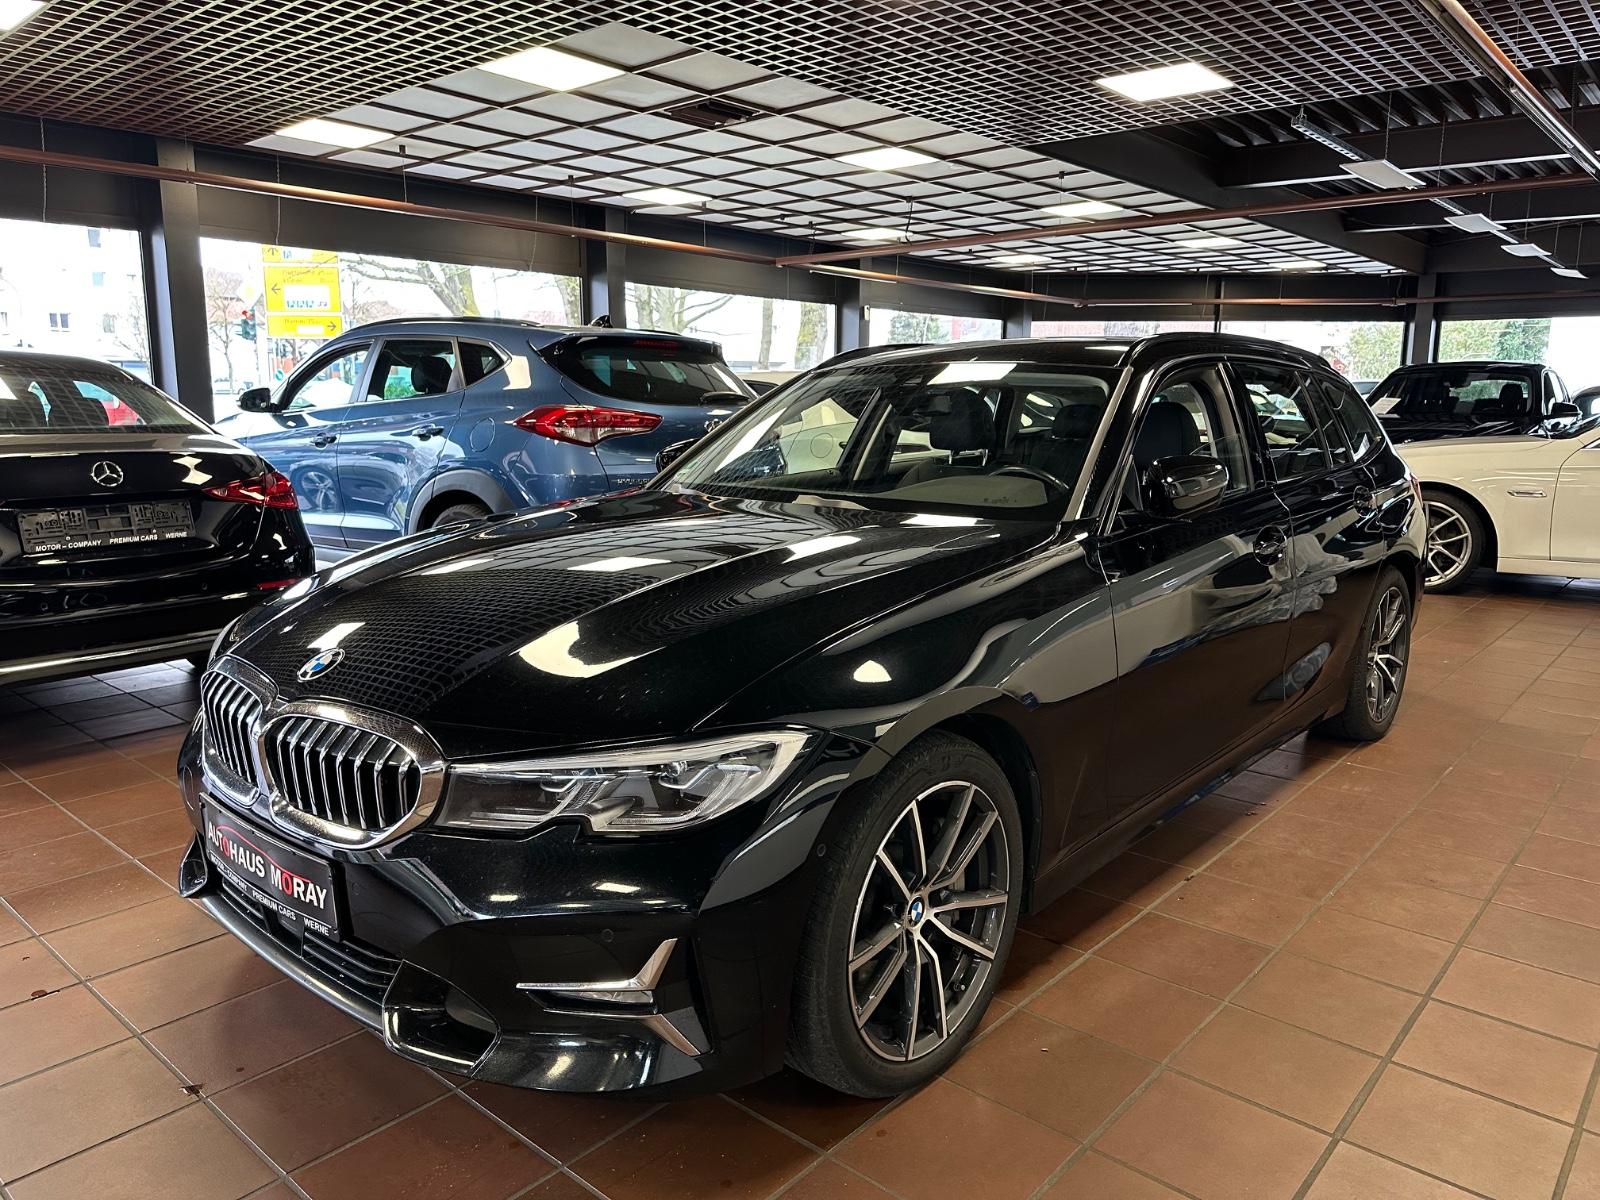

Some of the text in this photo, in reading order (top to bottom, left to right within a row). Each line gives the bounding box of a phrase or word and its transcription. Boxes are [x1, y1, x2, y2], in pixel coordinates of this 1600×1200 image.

[35, 544, 61, 552] MOTOR
[68, 540, 102, 549] COMPANY
[109, 536, 140, 545] PREMIUM
[140, 534, 158, 542] CARS
[165, 531, 187, 539] WERNE
[208, 821, 327, 910] AUTOHAUS MORAY
[252, 890, 279, 912] PREMIUM
[278, 905, 297, 921] CARS
[303, 916, 330, 937] WERNE
